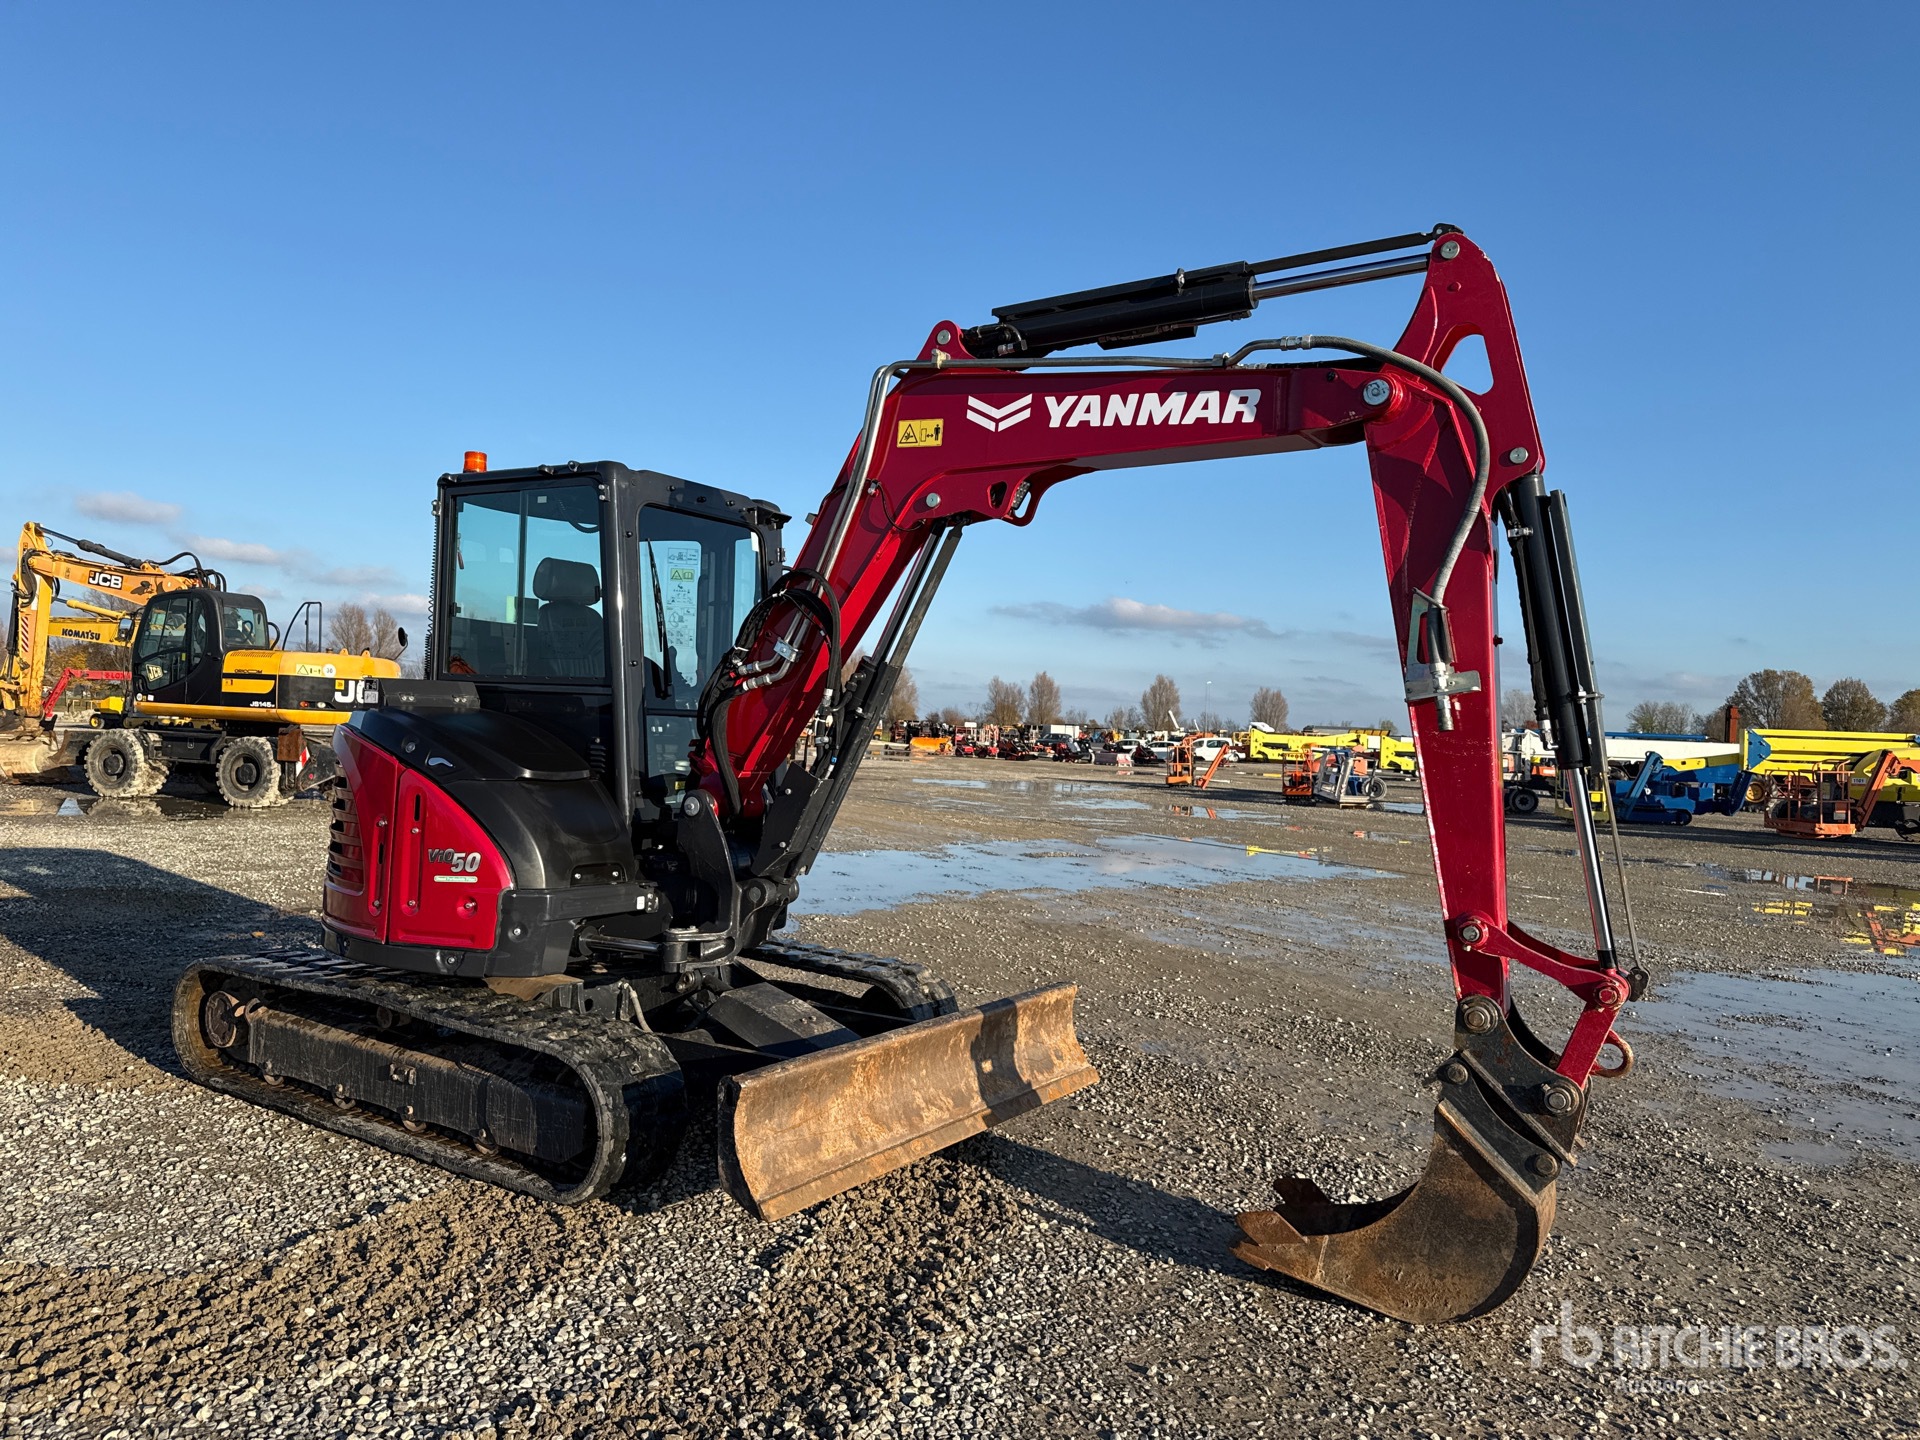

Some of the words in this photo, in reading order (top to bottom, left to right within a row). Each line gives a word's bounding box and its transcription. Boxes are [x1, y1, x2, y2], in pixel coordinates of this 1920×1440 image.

[1044, 389, 1262, 428] YANMAR
[89, 572, 123, 589] JCB
[61, 628, 101, 641] KOMATSU
